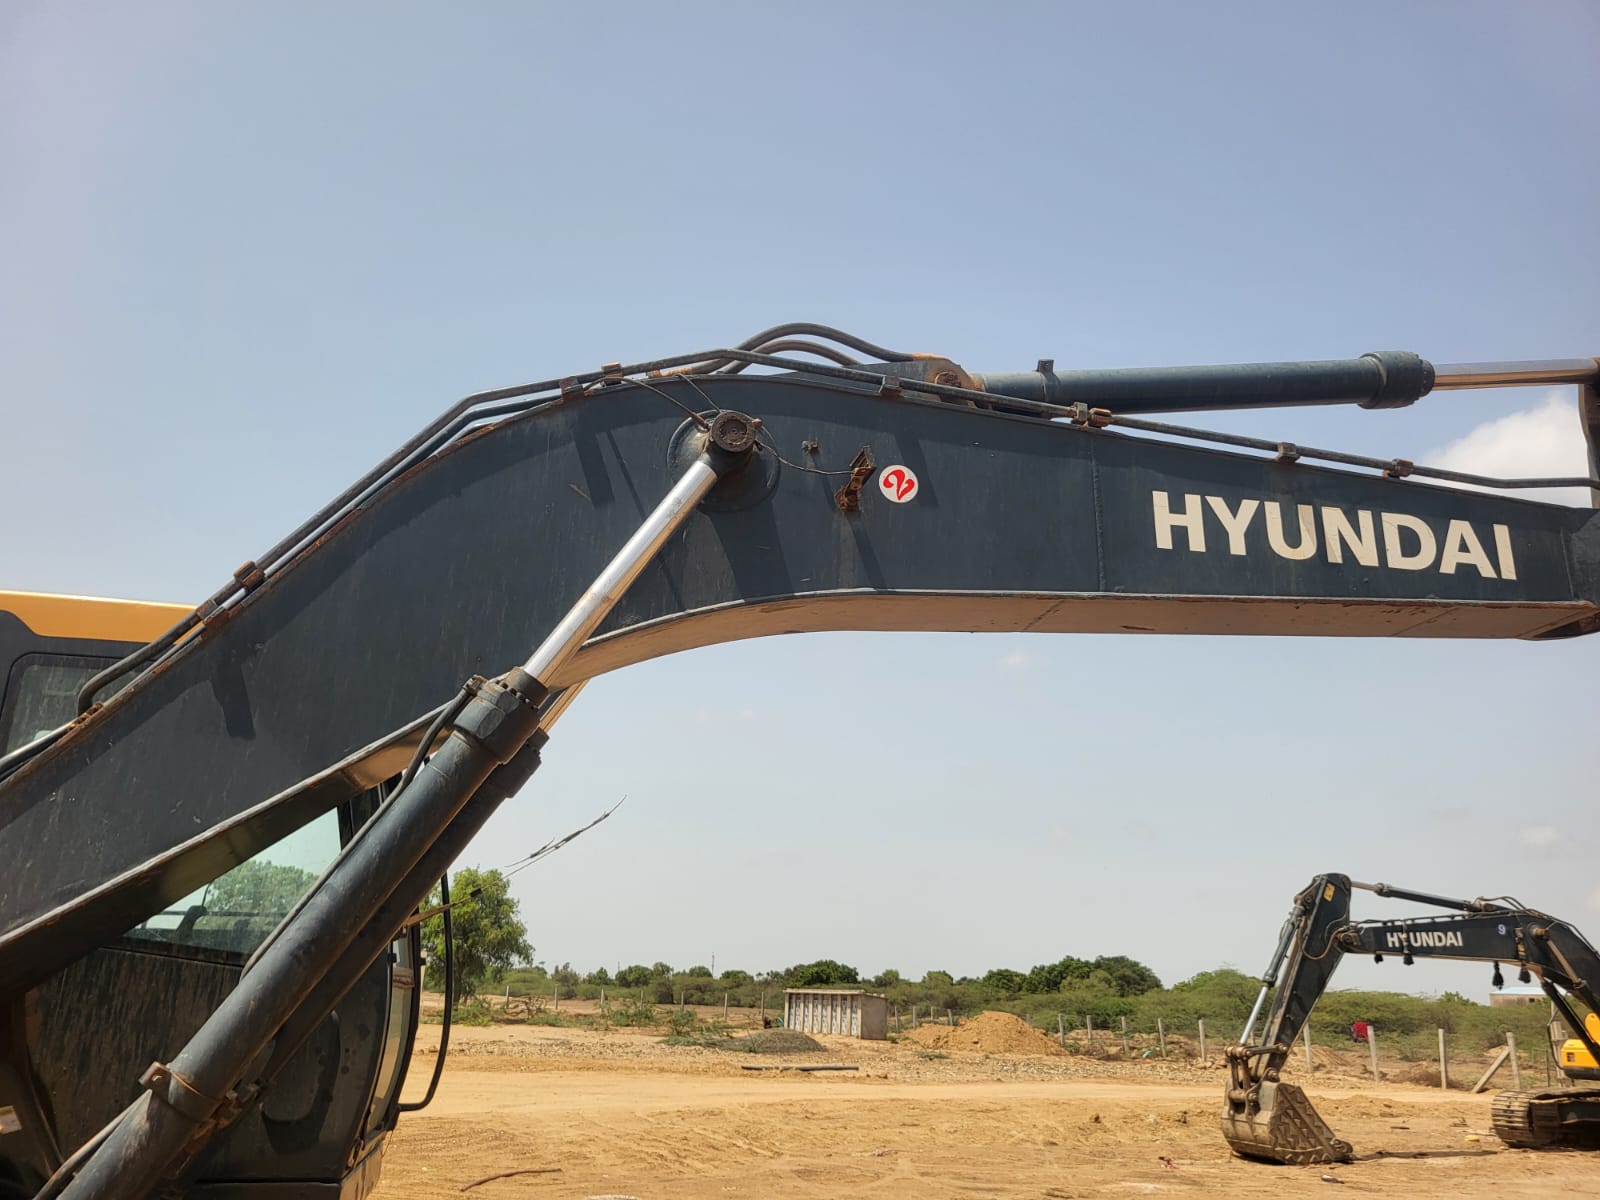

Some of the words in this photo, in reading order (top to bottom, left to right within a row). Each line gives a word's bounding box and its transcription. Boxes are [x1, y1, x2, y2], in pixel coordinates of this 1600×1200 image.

[1152, 491, 1517, 580] HYUNDAI
[1498, 924, 1506, 935] 9
[1386, 931, 1463, 948] HYUNDAI
